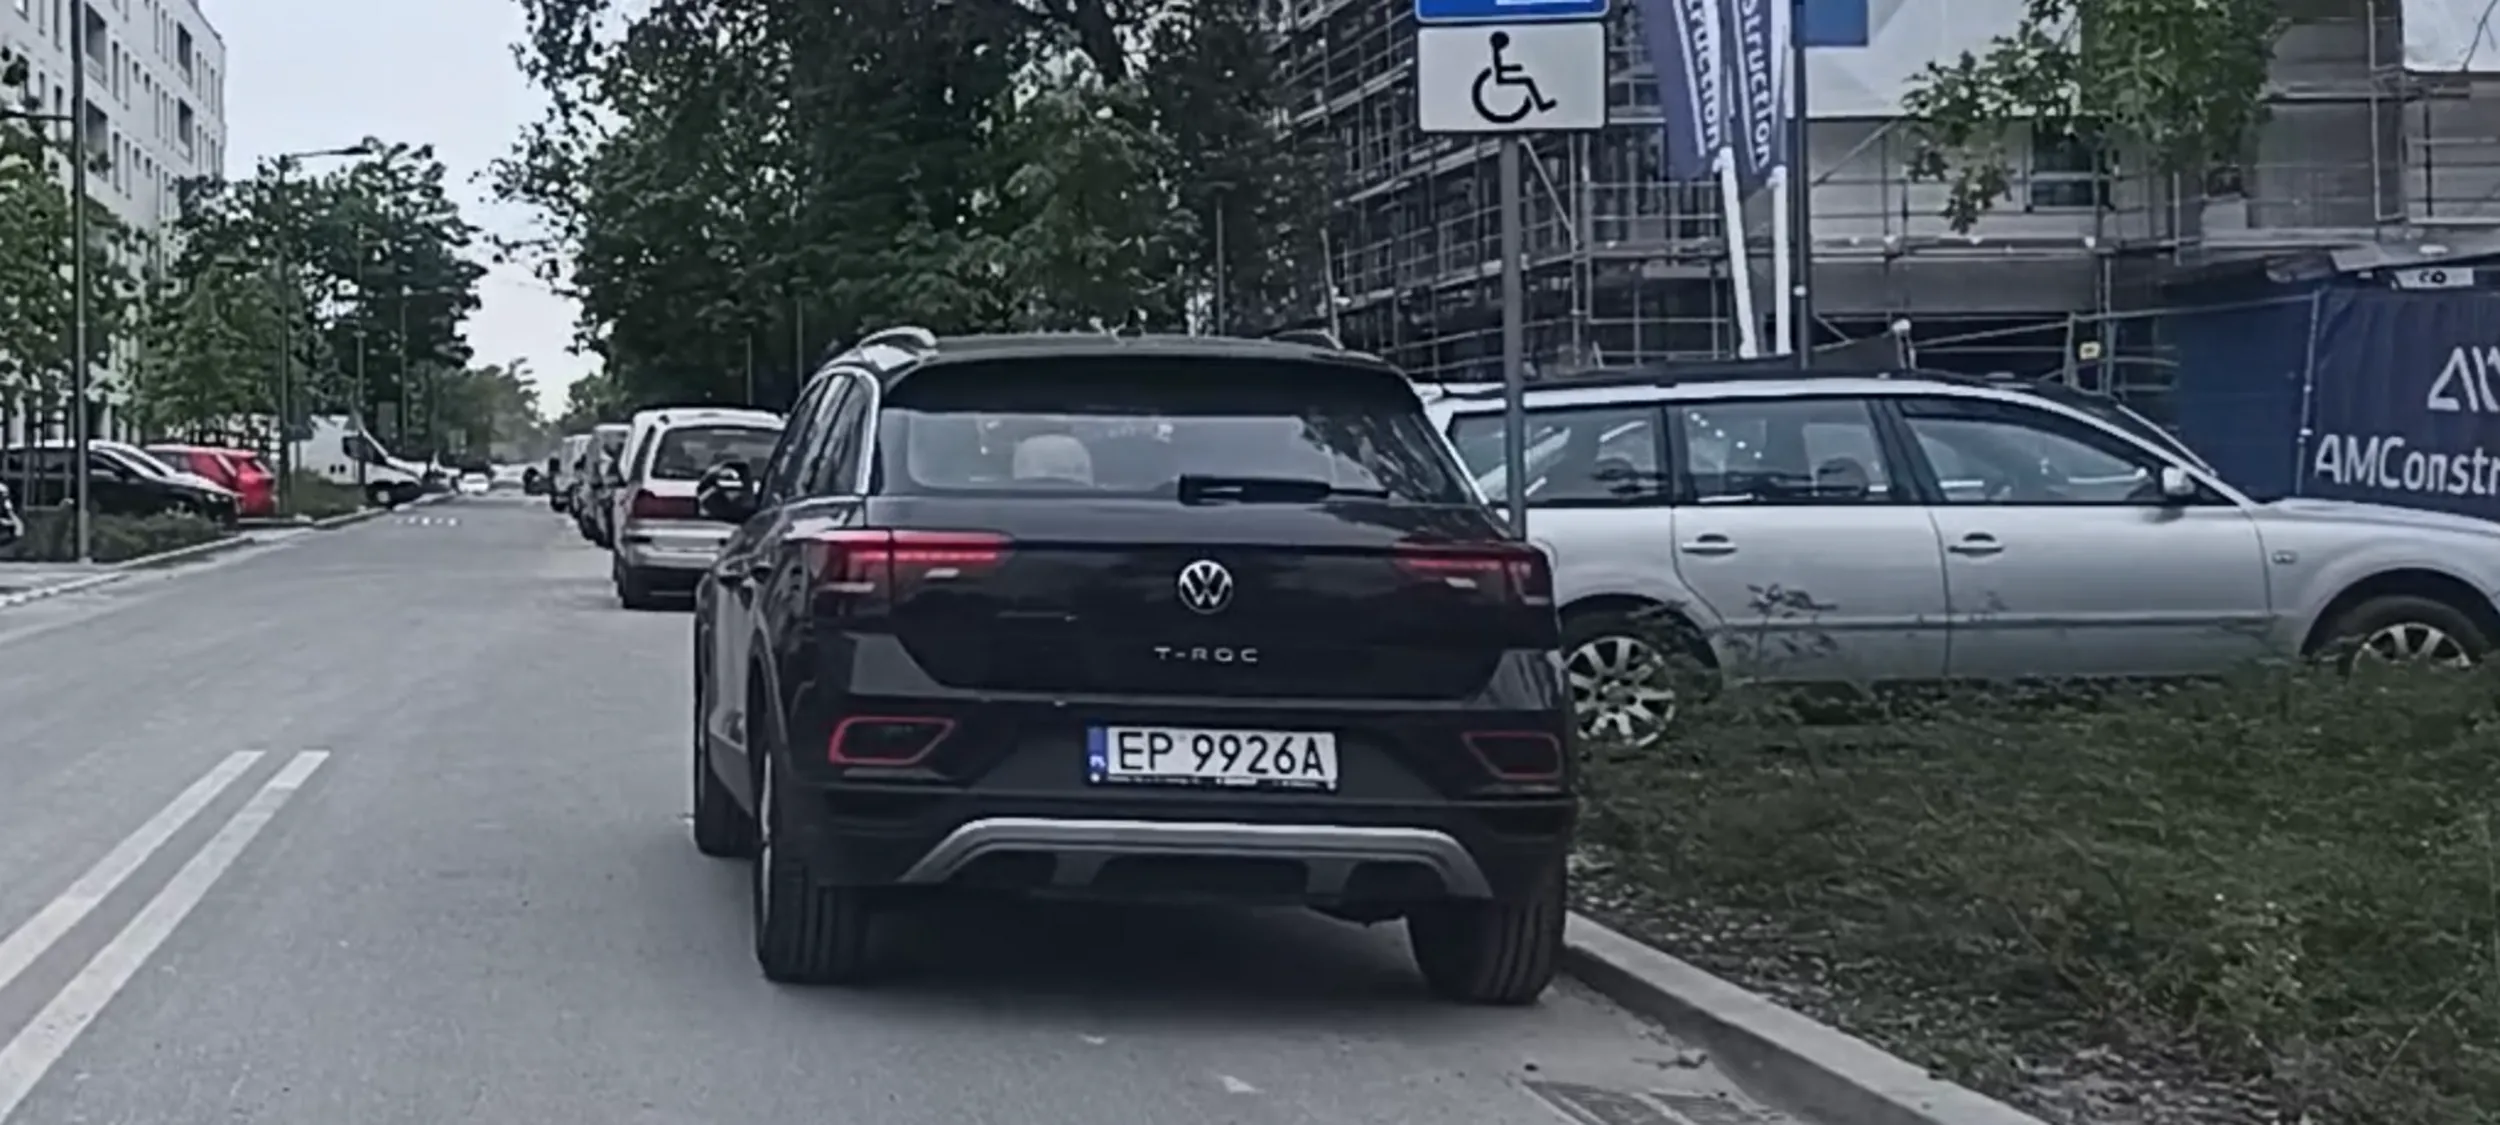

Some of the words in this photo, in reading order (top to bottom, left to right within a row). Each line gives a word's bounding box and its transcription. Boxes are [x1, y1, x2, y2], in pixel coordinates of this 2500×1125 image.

[2315, 434, 2500, 495] AMConstr
[1154, 646, 1258, 662] T-ROC
[1118, 731, 1173, 770] EP
[1192, 734, 1324, 776] 9926A
